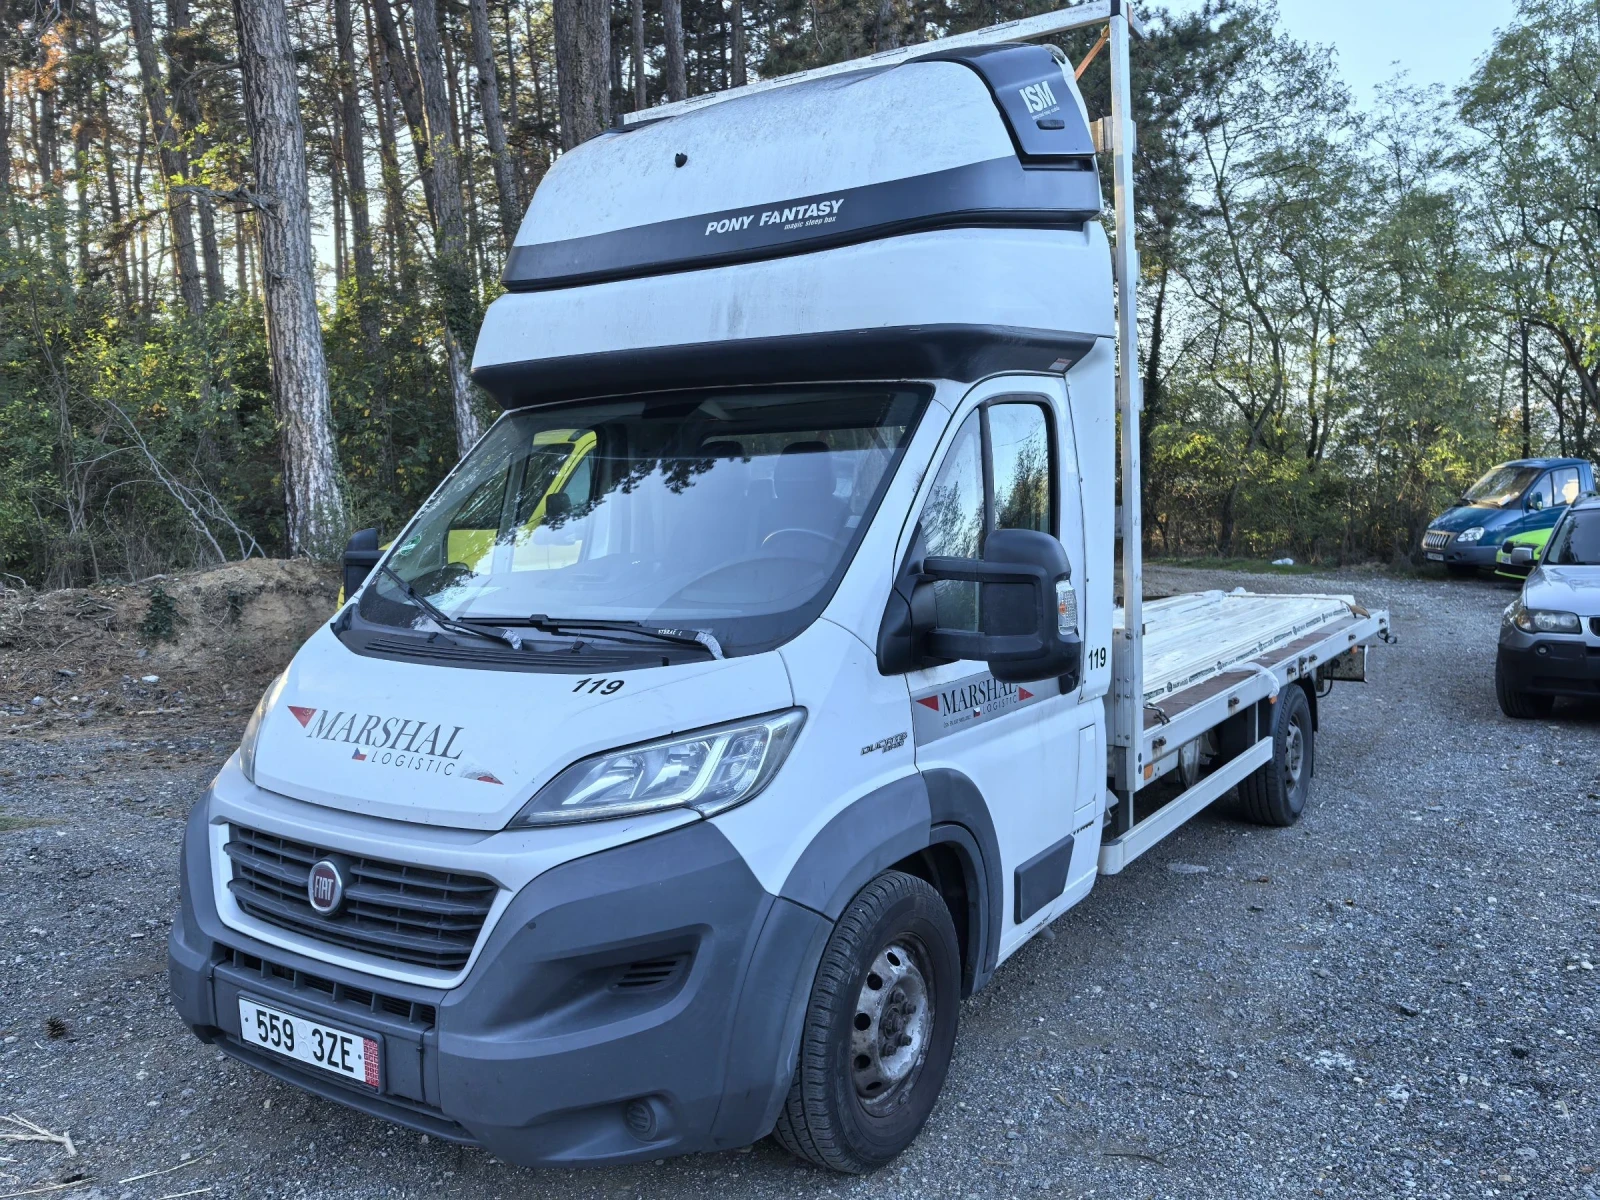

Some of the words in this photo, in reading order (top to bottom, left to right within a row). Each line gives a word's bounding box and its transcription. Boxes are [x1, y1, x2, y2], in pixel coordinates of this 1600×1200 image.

[1019, 80, 1057, 113] ISM
[705, 215, 755, 235] PONY
[759, 199, 844, 226] FANTASY
[784, 221, 804, 230] magic
[804, 218, 823, 227] sleep
[823, 216, 837, 224] box
[1088, 647, 1106, 671] 119
[572, 677, 625, 696] 119
[983, 694, 1017, 715] LOGISTIC
[306, 709, 464, 760] MARSHAL
[371, 750, 455, 776] LOGISTIC
[314, 875, 334, 901] FIAT
[256, 1008, 295, 1052] 559
[311, 1028, 355, 1073] 3ZE
